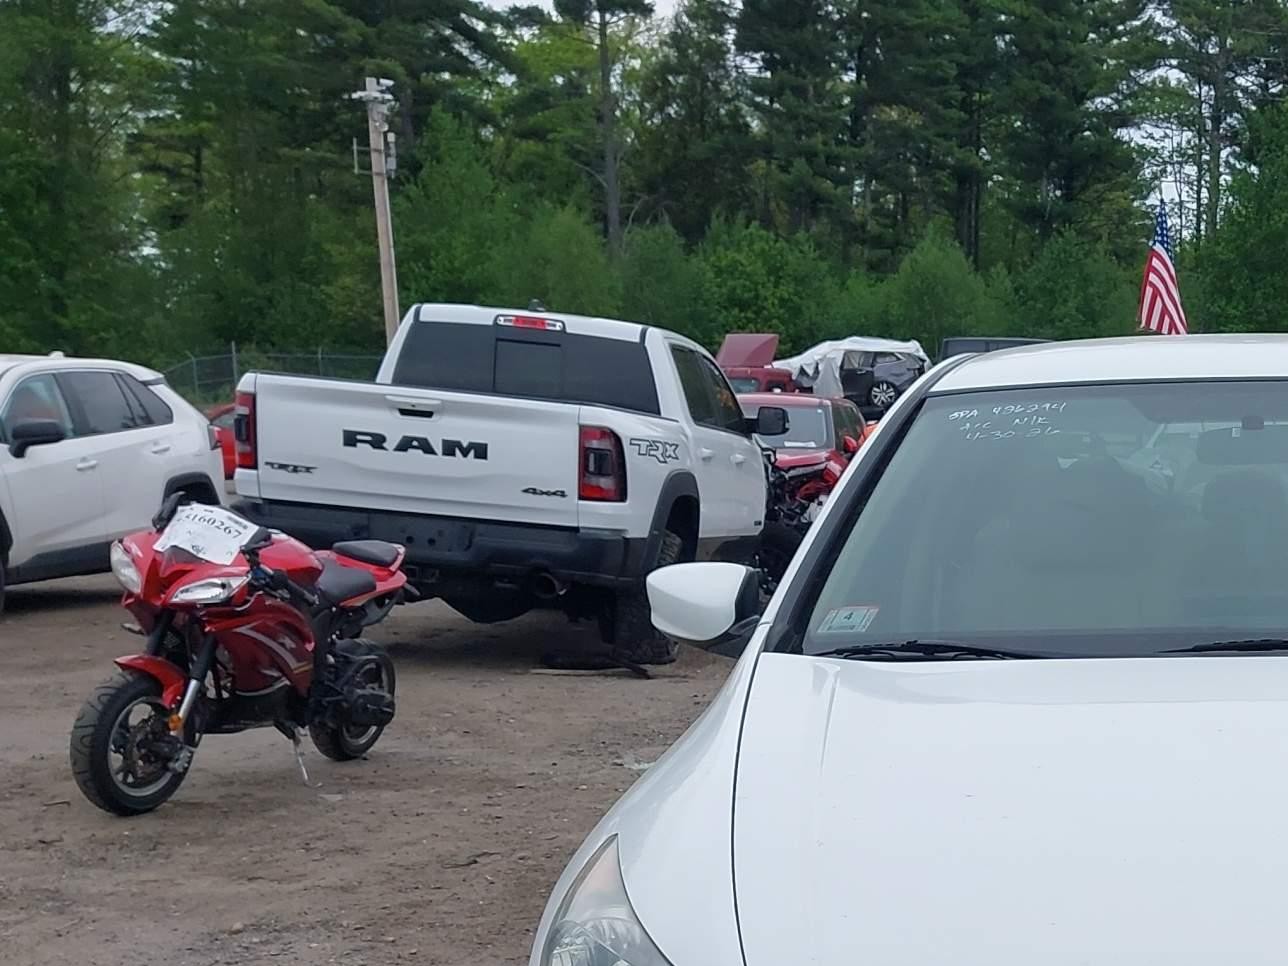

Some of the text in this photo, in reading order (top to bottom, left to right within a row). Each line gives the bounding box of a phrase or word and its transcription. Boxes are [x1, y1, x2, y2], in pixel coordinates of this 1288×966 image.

[341, 428, 489, 461] RAM
[629, 437, 680, 464] TRX
[521, 487, 568, 498] 4x4
